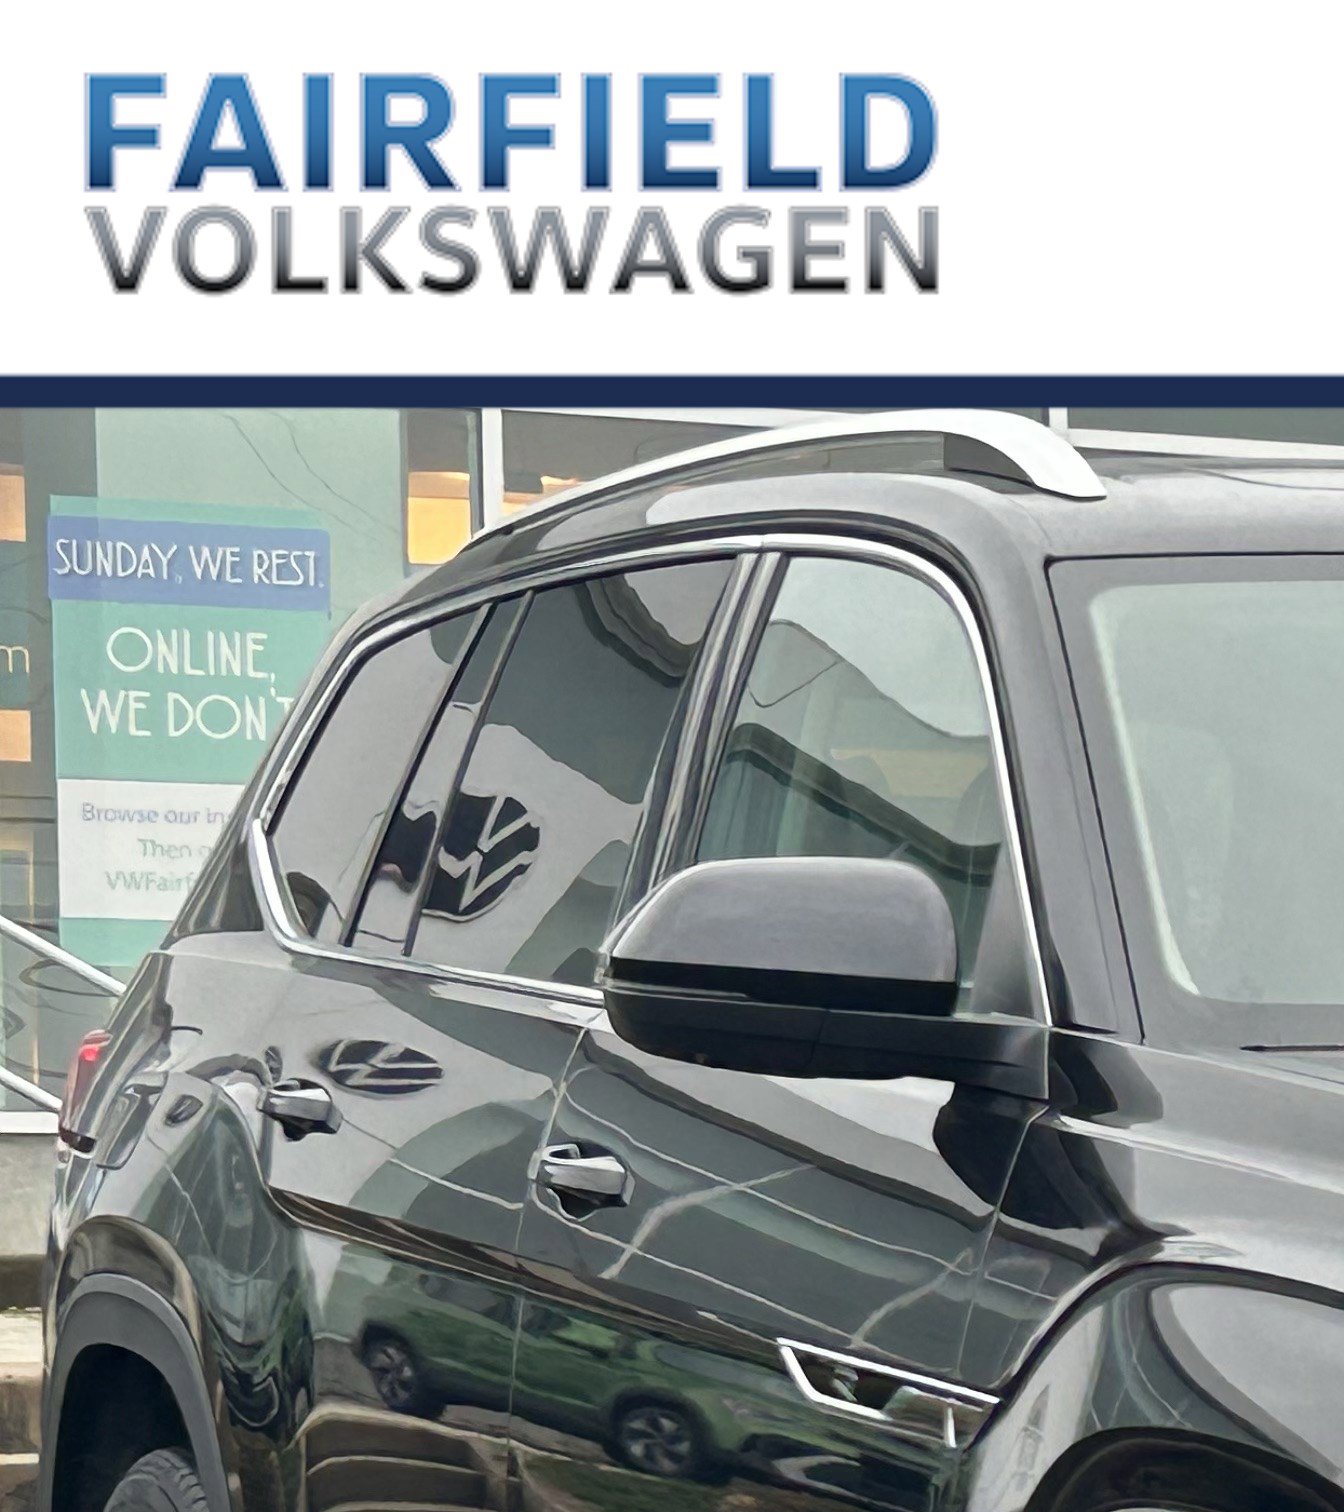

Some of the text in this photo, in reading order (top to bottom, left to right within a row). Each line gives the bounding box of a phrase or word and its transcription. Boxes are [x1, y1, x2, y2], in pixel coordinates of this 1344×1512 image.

[188, 545, 243, 584] WE
[106, 626, 275, 684] ONLINE,
[80, 688, 151, 736] WE
[82, 802, 159, 824] Browse
